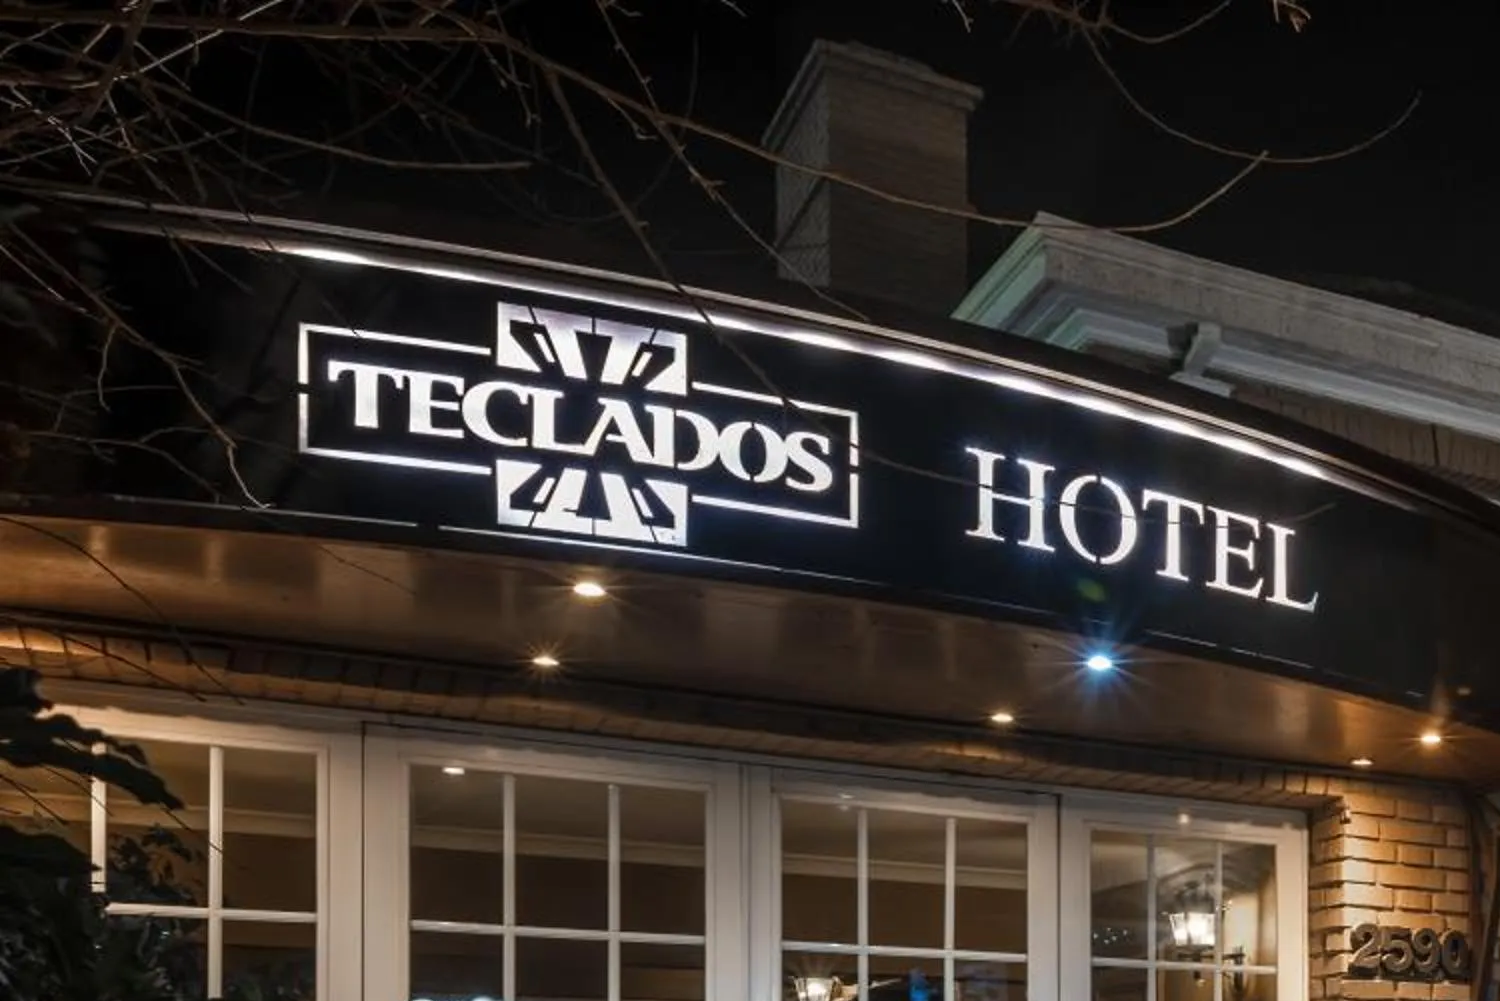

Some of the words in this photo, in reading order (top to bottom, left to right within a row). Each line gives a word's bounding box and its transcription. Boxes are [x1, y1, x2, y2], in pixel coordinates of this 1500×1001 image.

[328, 359, 834, 492] TECLADOS
[965, 447, 1319, 613] HOTEL
[1349, 923, 1470, 979] 2590
